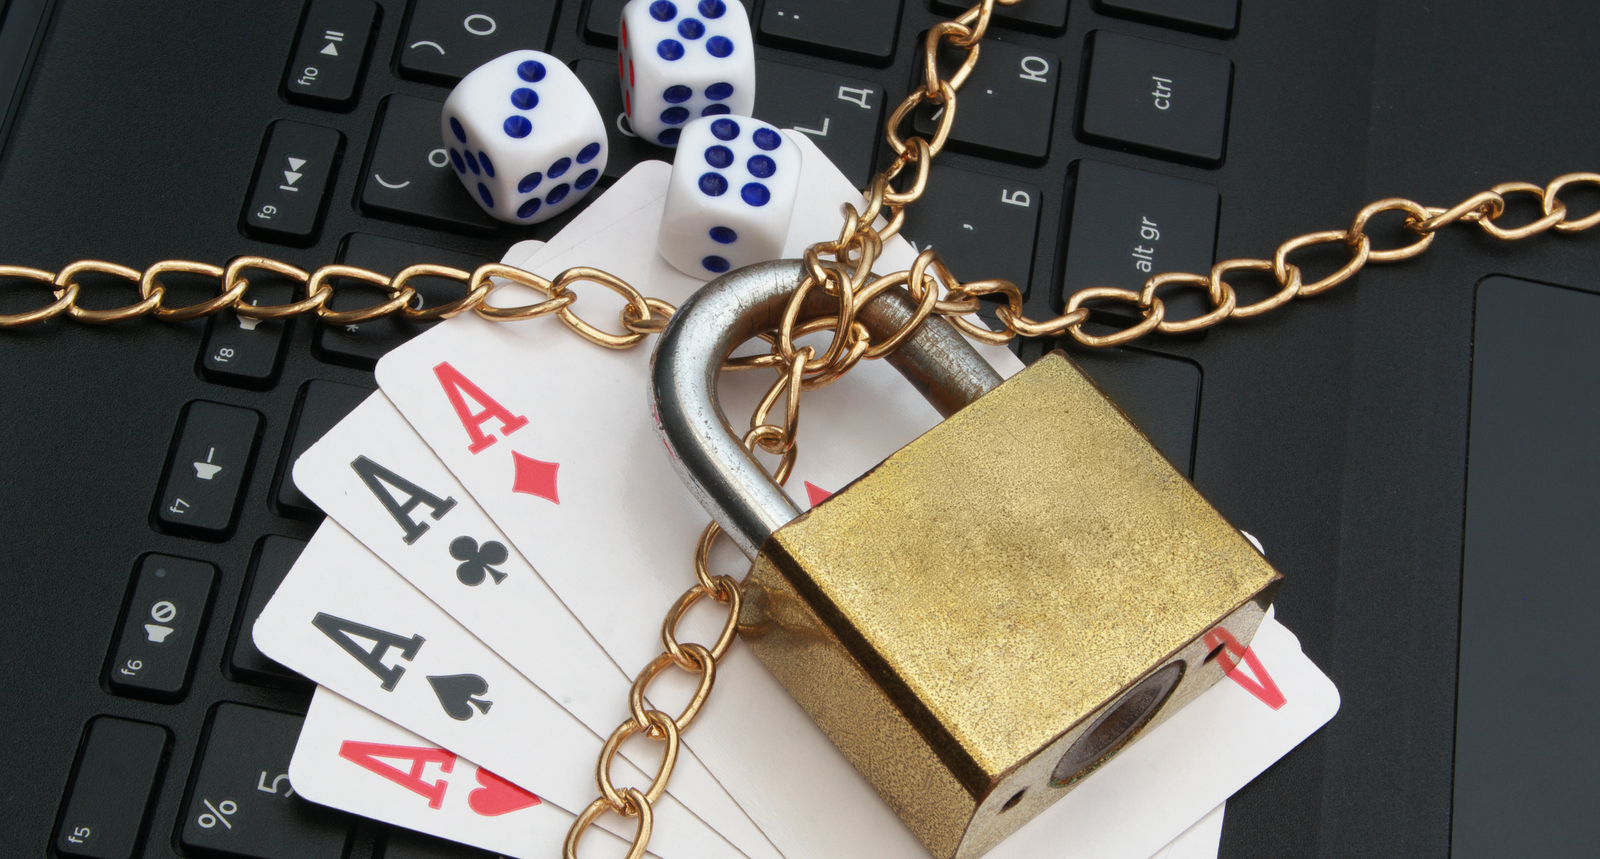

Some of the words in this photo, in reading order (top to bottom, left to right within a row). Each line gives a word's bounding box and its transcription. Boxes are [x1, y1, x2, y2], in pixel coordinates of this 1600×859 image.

[298, 67, 318, 85] f10
[1020, 56, 1049, 82] Ю
[838, 86, 873, 109] Д
[1152, 77, 1172, 109] ctrl
[793, 117, 829, 136] L
[1002, 189, 1030, 207] Б
[257, 205, 277, 219] f9
[1141, 217, 1159, 240] gr
[1132, 245, 1153, 272] alt
[214, 348, 234, 362] f8
[433, 361, 529, 454] A
[170, 499, 189, 513] f7
[350, 454, 458, 545] A
[311, 612, 426, 692] A
[121, 660, 142, 675] f6
[257, 771, 294, 797] 5
[339, 740, 457, 809] A
[198, 799, 237, 829] %
[68, 827, 90, 843] f5
